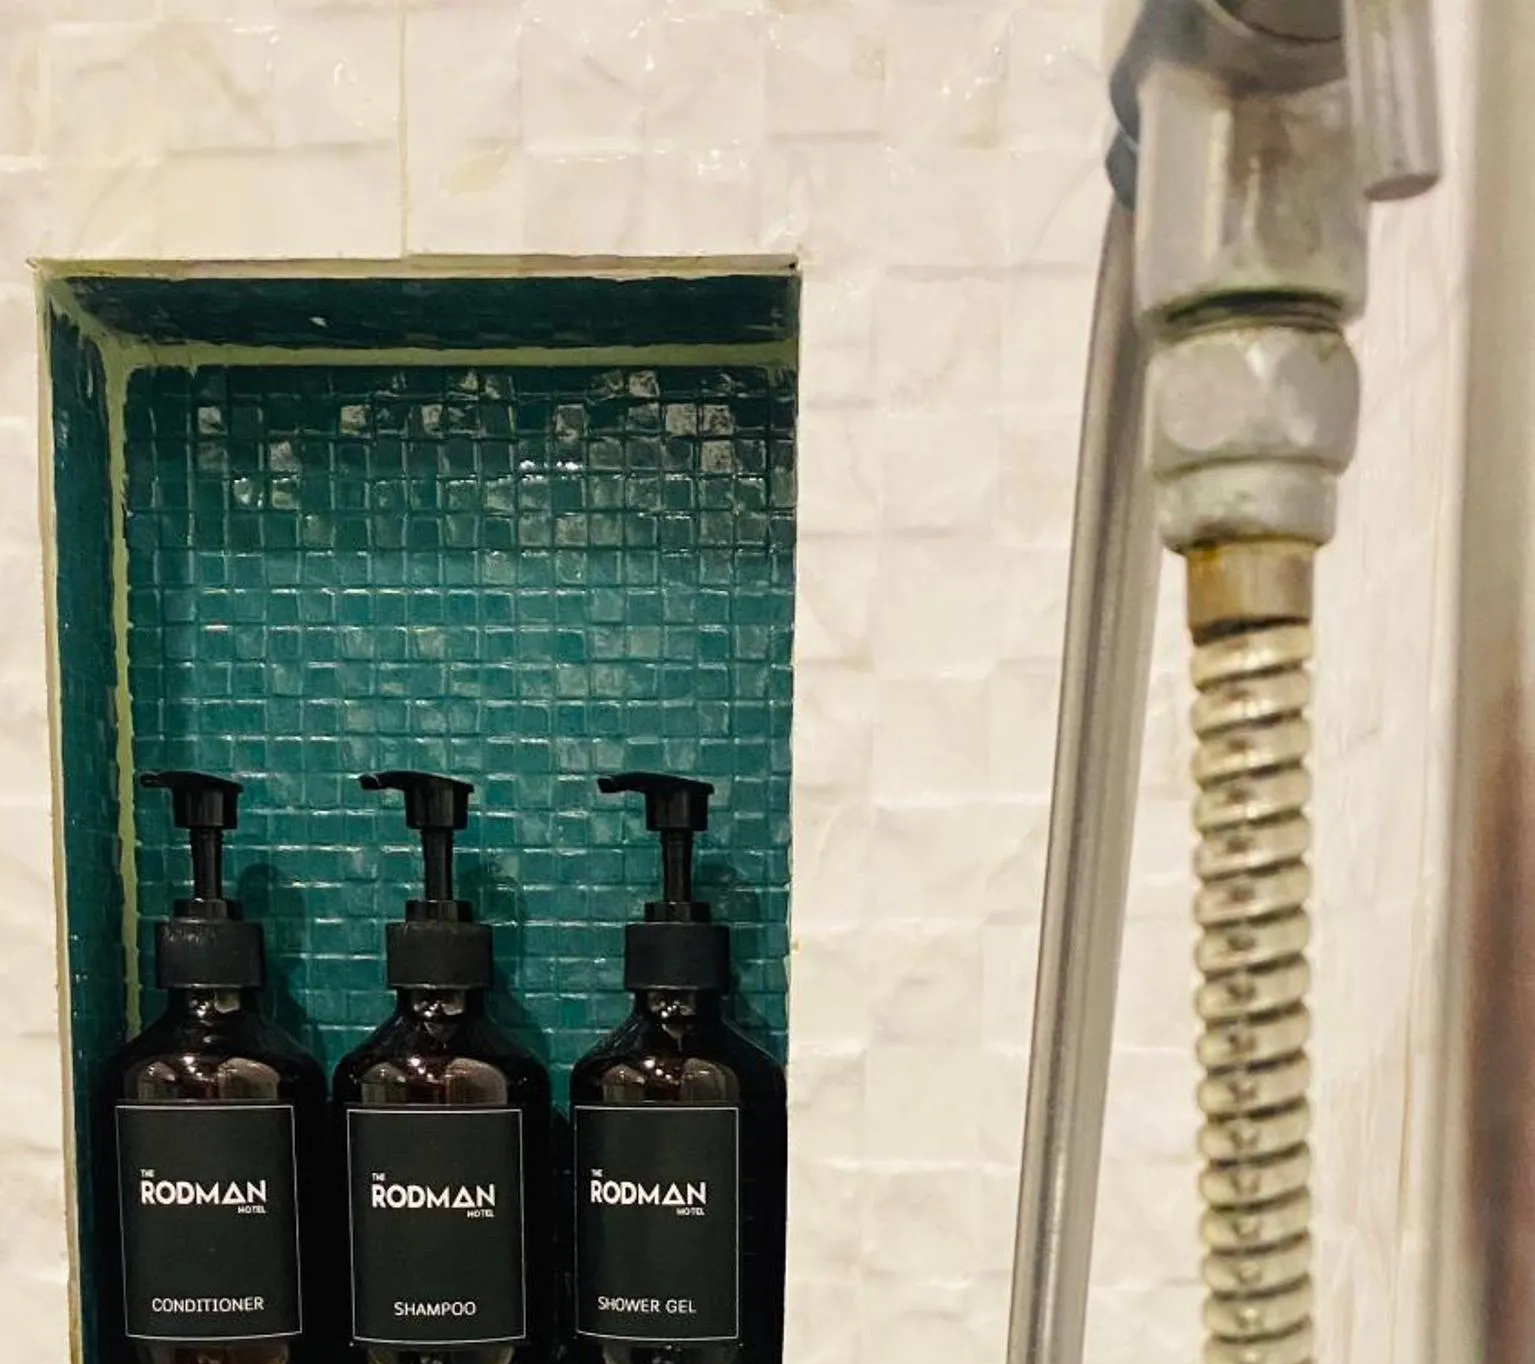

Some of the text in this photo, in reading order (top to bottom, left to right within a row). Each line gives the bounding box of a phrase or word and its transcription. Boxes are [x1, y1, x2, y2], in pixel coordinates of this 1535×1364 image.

[140, 1179, 267, 1205] RODMAN
[371, 1183, 496, 1209] RODMAN
[590, 1180, 707, 1206] RODMAN
[237, 1205, 266, 1214] HOTEL
[466, 1209, 495, 1218] HOTEL
[151, 1296, 265, 1313] CONDITIONER
[393, 1301, 477, 1317] SHAMPOO
[597, 1296, 697, 1314] SHOWER GEL
